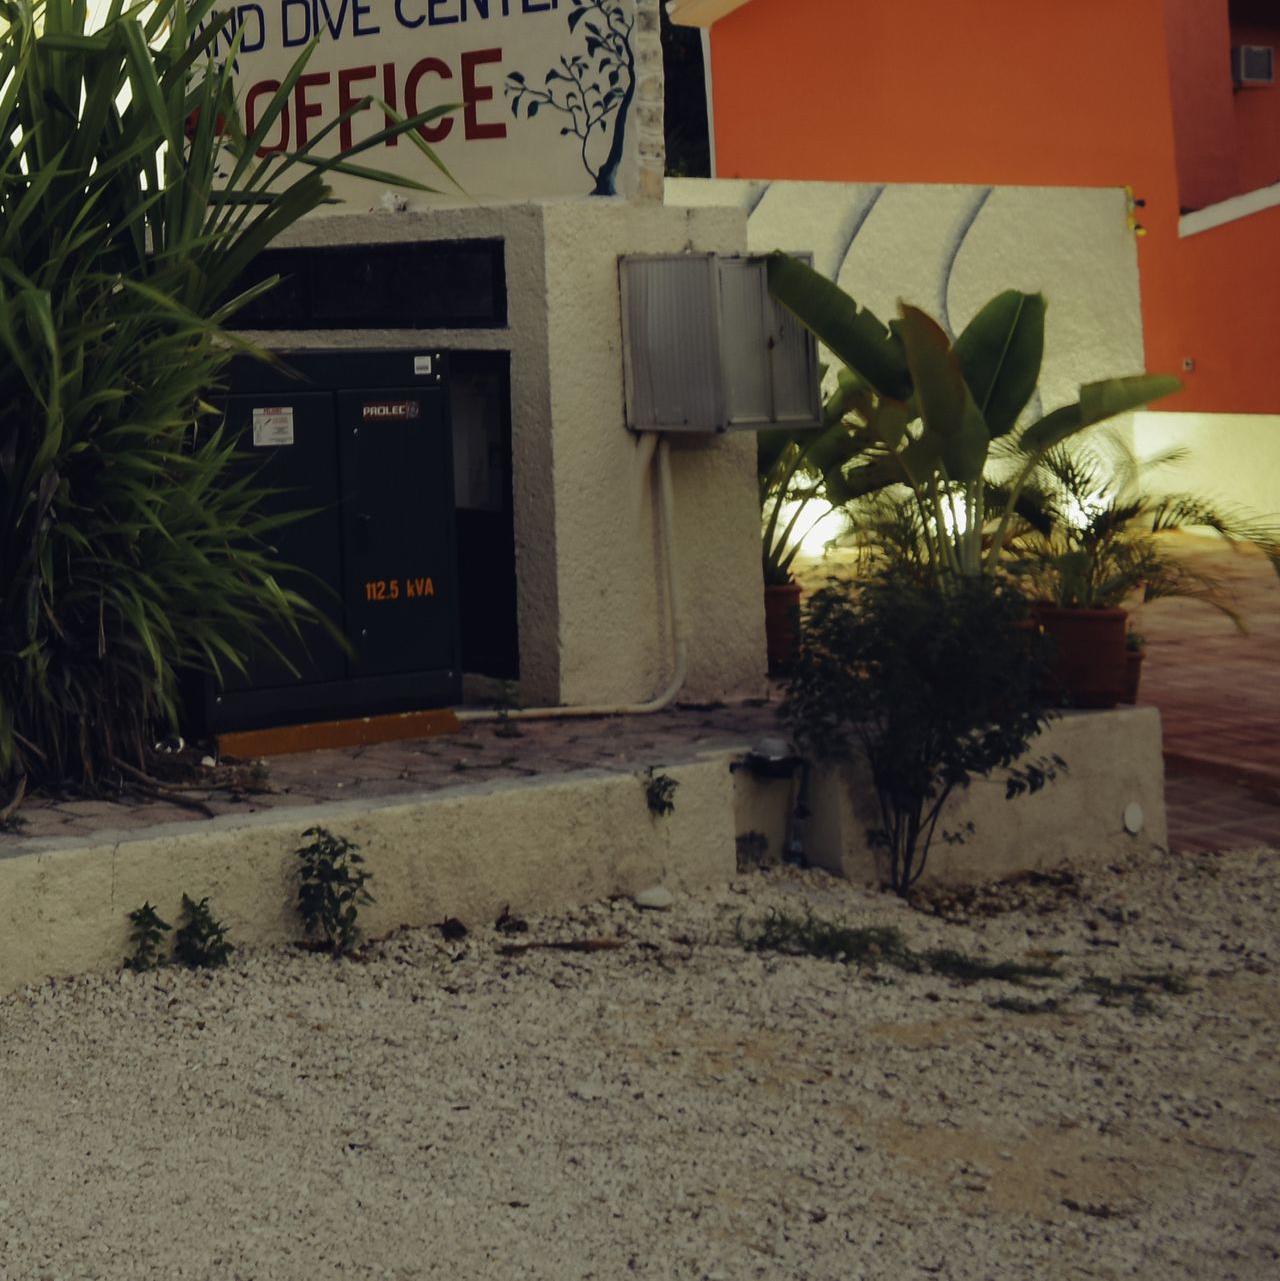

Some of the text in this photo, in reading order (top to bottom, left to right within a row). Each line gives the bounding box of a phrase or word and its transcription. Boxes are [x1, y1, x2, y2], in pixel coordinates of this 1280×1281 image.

[245, 47, 507, 159] OFFICE
[362, 404, 406, 417] PROLEC
[366, 578, 434, 601] 112.5 kVA
